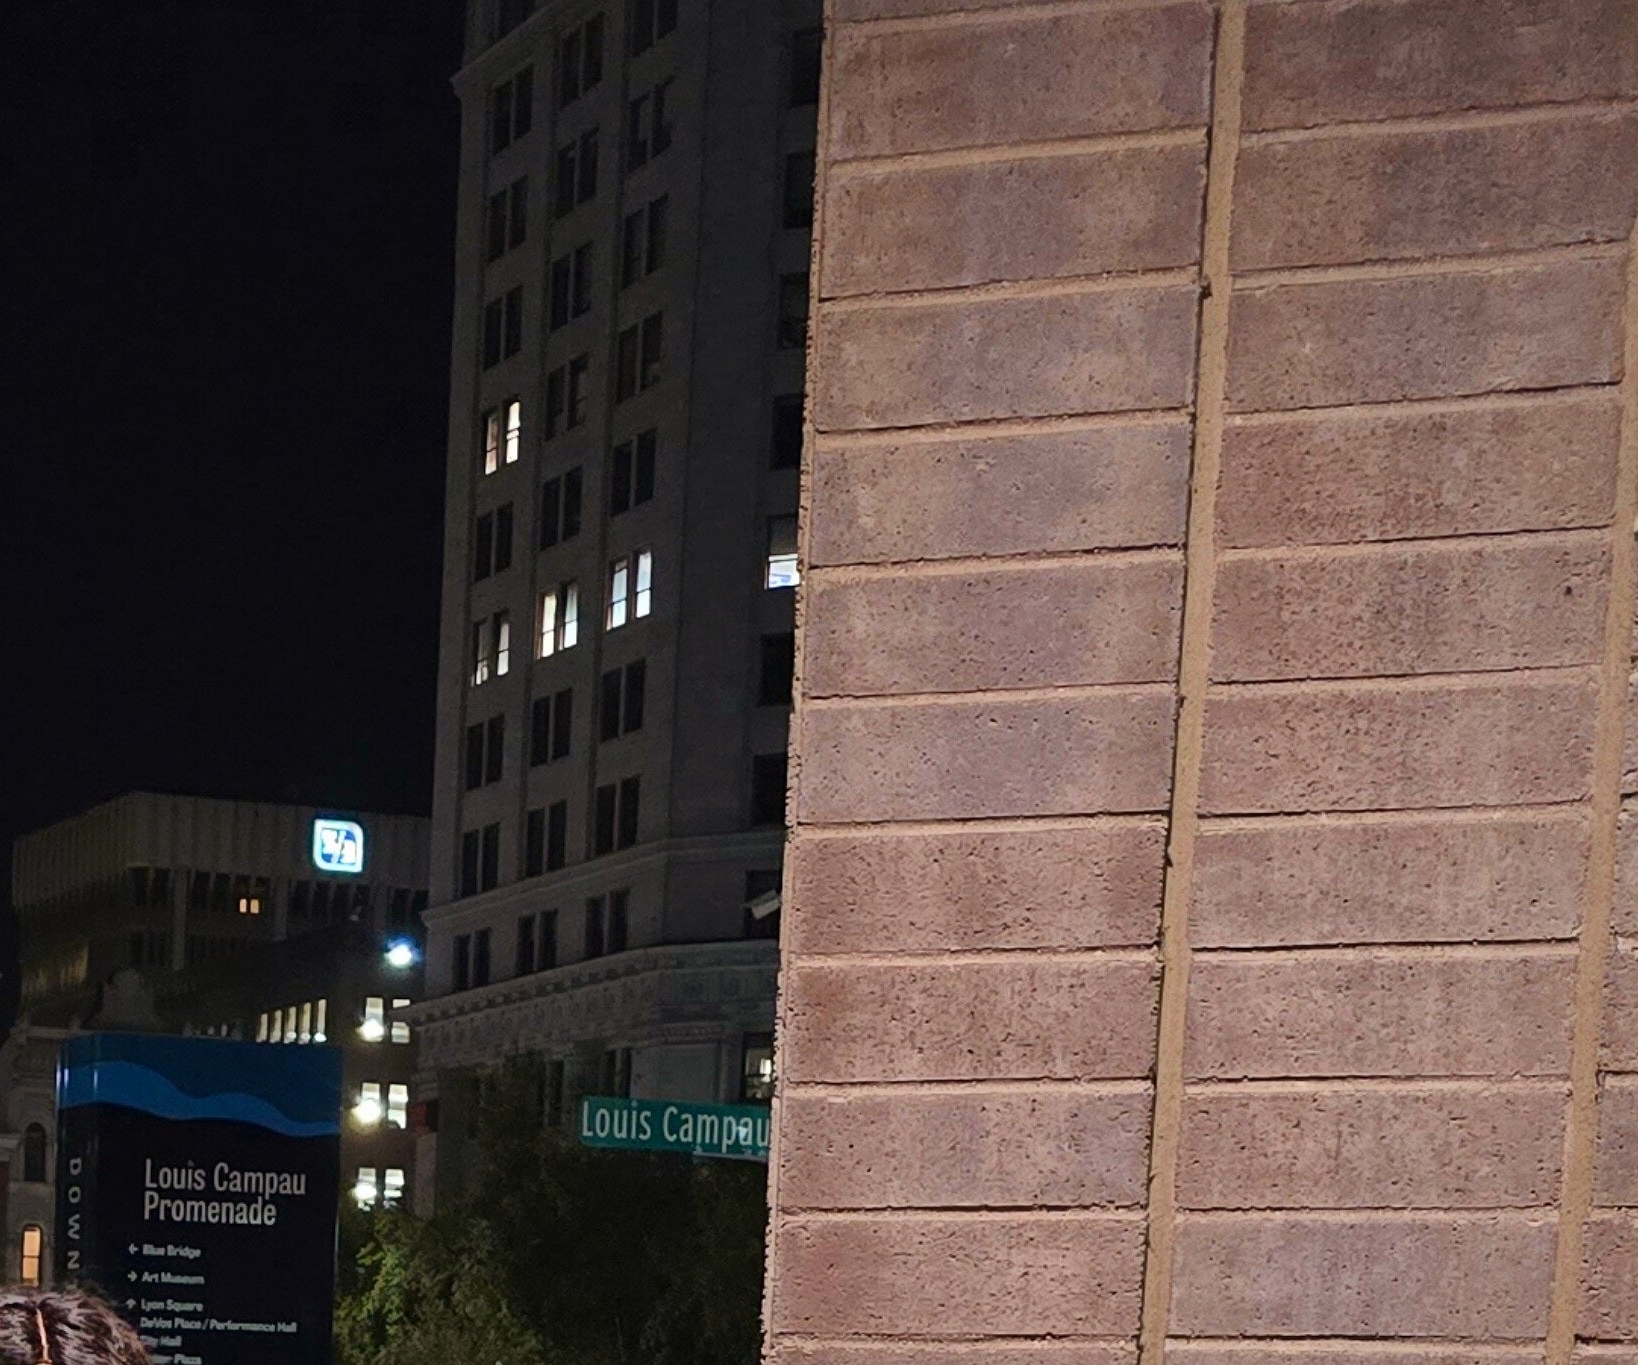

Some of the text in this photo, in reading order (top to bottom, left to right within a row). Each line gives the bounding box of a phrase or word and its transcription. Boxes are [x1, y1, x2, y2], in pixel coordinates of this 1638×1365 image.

[581, 1099, 770, 1154] Louis Campau
[144, 1157, 307, 1200] Louis Campau
[143, 1190, 278, 1226] Promenade
[166, 1244, 202, 1260] Bridge
[141, 1271, 206, 1285] Art Museum
[140, 1299, 204, 1312] Lyon Square
[139, 1317, 173, 1329] DeVos
[174, 1317, 202, 1330] Place
[209, 1318, 276, 1332] Performance
[276, 1321, 298, 1333] Hall
